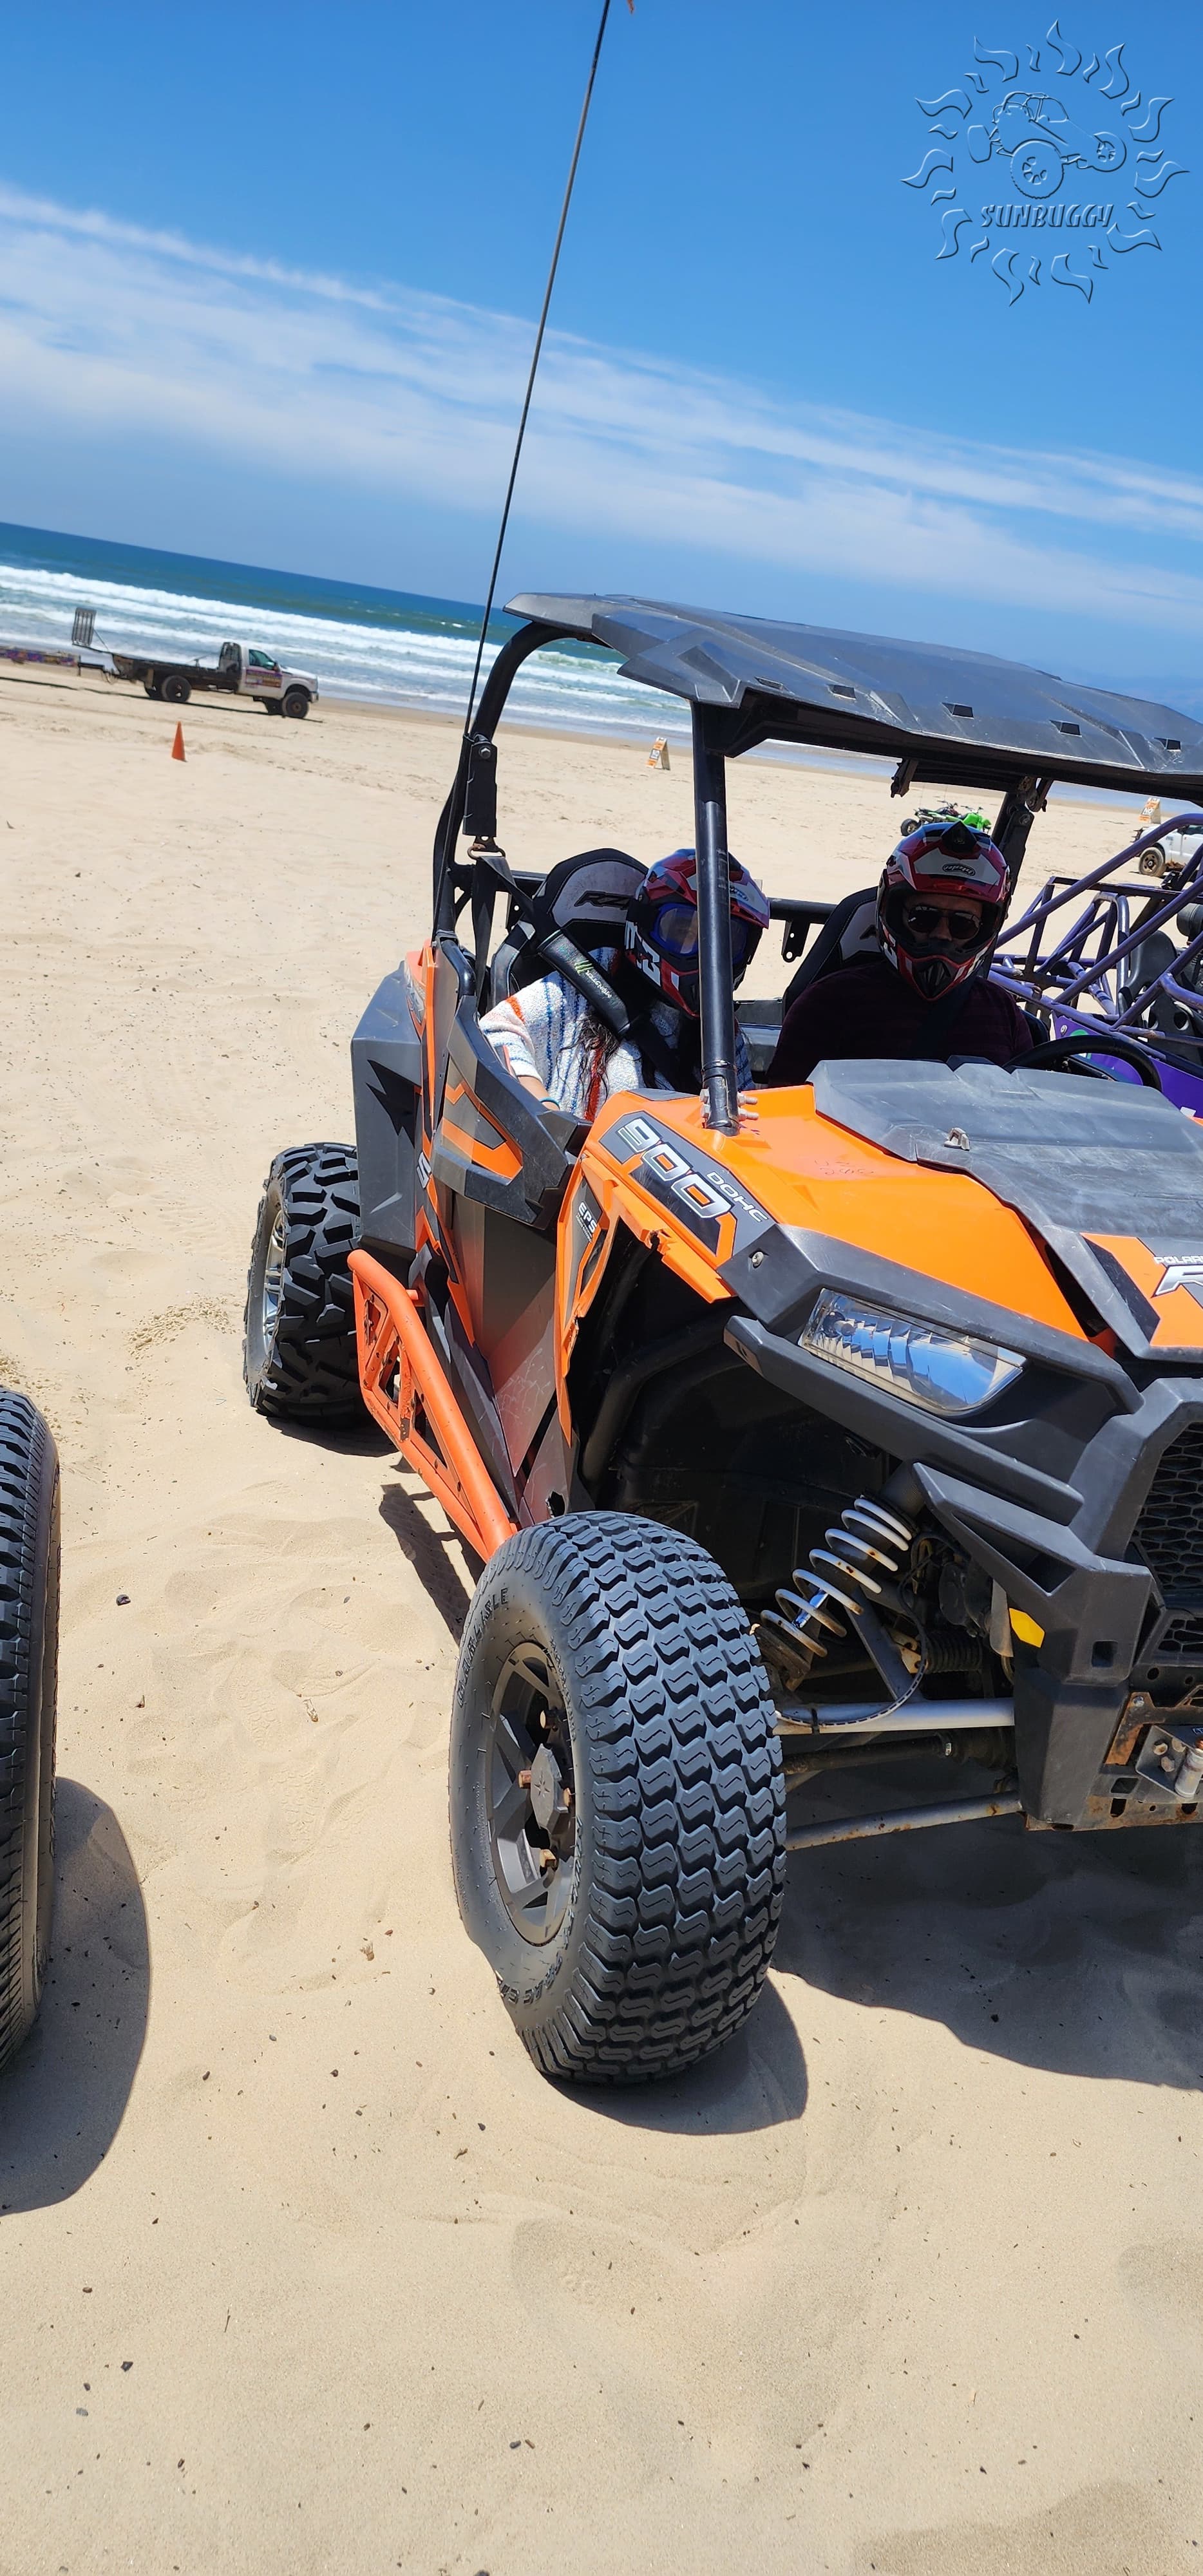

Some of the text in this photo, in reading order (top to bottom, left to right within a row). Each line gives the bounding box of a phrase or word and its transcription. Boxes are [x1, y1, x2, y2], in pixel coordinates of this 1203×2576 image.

[574, 890, 630, 909] RZ
[585, 969, 613, 999] MONSTER
[617, 1117, 732, 1219] 900
[706, 1171, 768, 1223] DOHC
[578, 1202, 598, 1234] EPS
[1153, 1255, 1203, 1264] POLAR
[457, 1587, 509, 1709] CARLISLE
